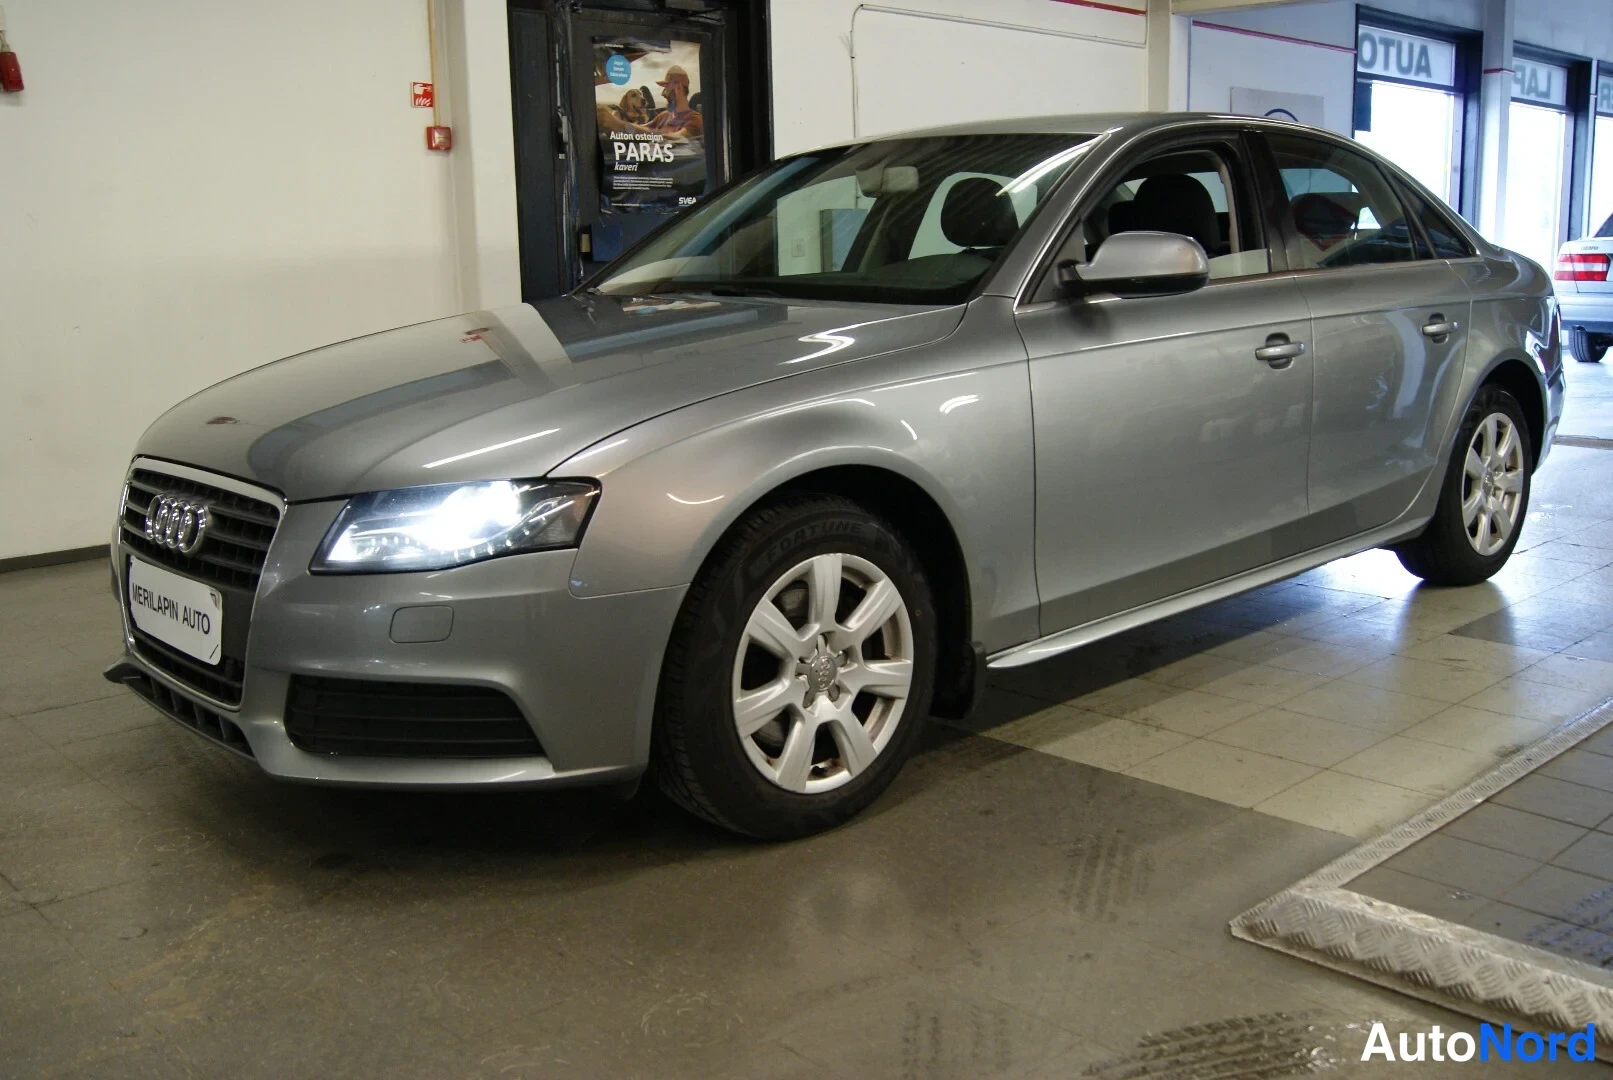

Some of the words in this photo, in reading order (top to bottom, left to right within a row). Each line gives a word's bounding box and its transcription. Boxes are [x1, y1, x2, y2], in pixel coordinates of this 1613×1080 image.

[610, 131, 634, 140] Auton
[635, 133, 664, 142] ostajan
[613, 141, 674, 163] PARAS
[614, 162, 639, 171] kaveri
[678, 196, 697, 205] SVEA
[766, 520, 863, 563] FORTUNE
[132, 582, 179, 621] MERILAPIN
[182, 605, 211, 635] AUTO
